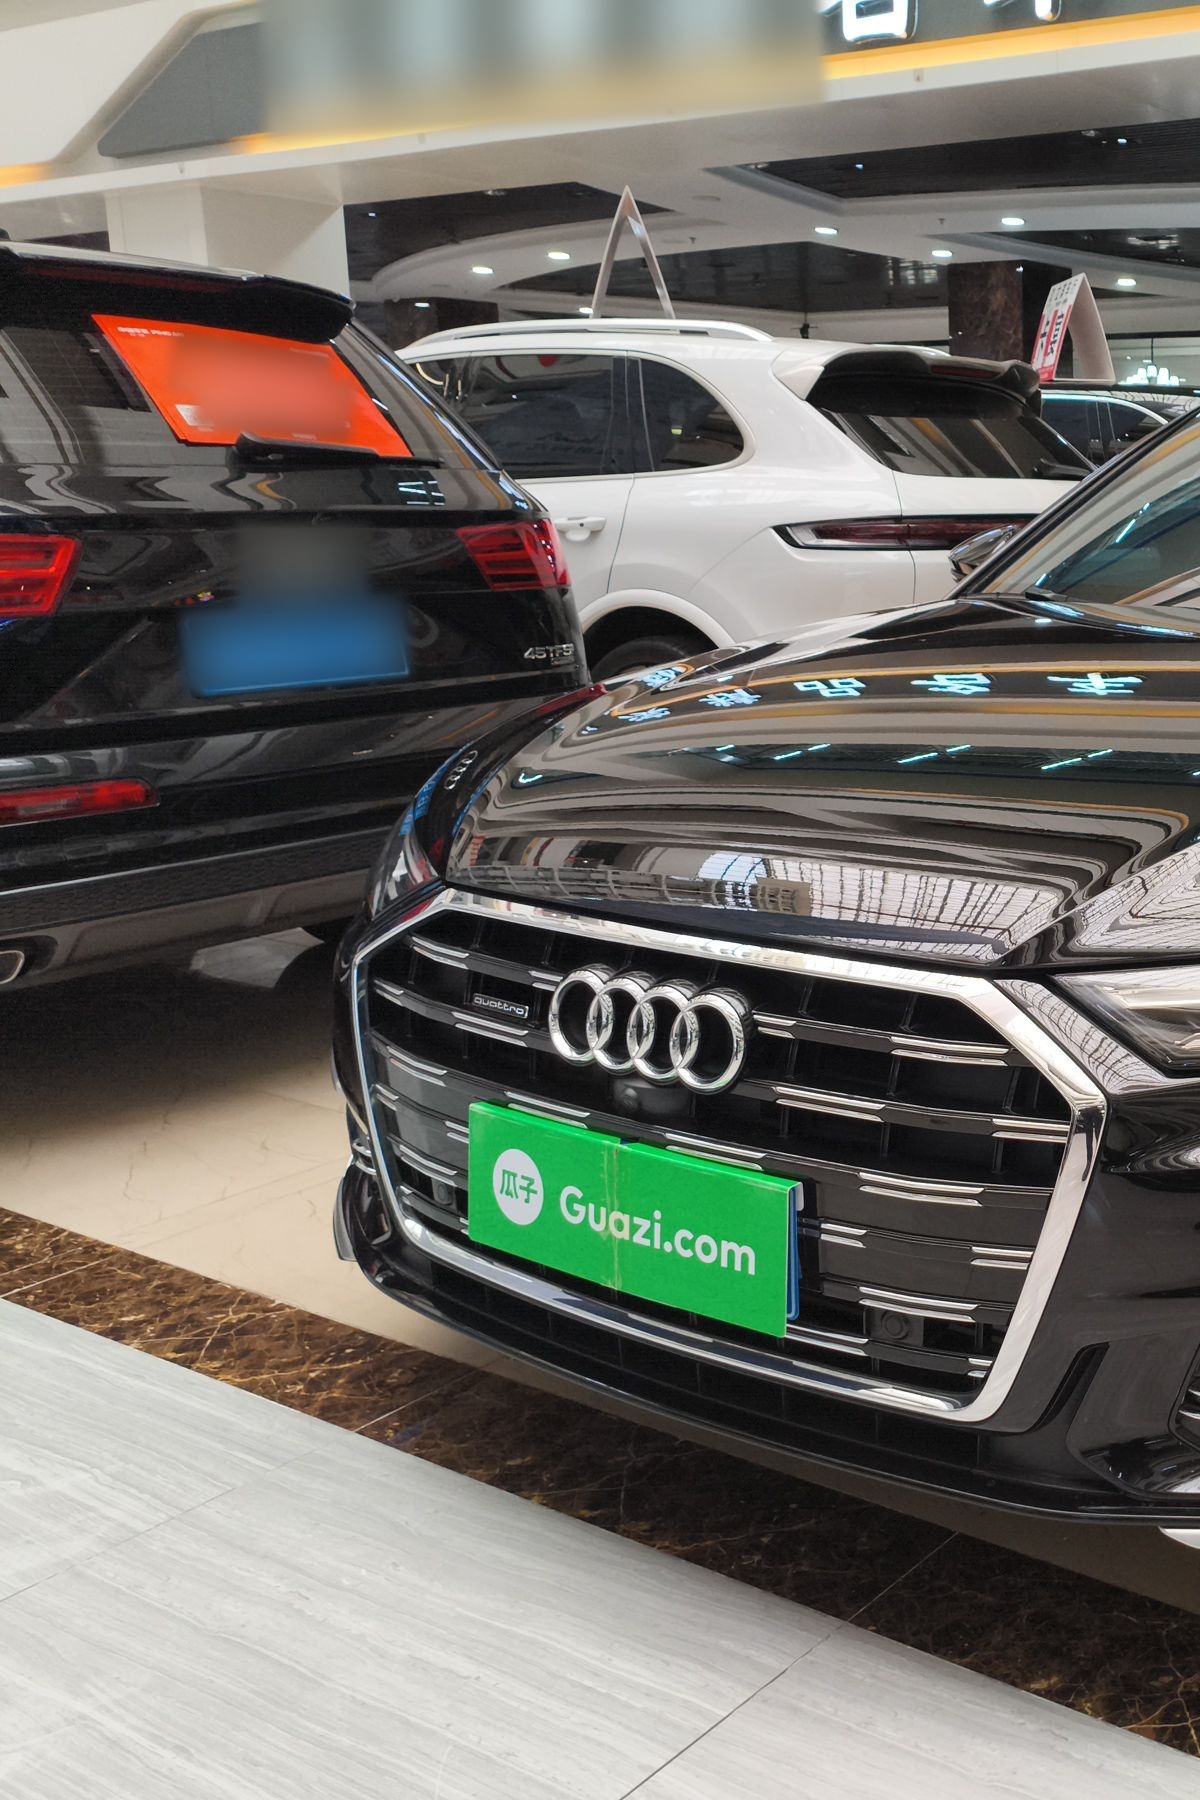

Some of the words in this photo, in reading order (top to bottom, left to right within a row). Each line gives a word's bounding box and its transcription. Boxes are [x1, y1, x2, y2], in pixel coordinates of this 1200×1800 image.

[473, 996, 525, 1015] quattro
[499, 1168, 539, 1204] 瓜子
[559, 1185, 757, 1276] Guazi.com
